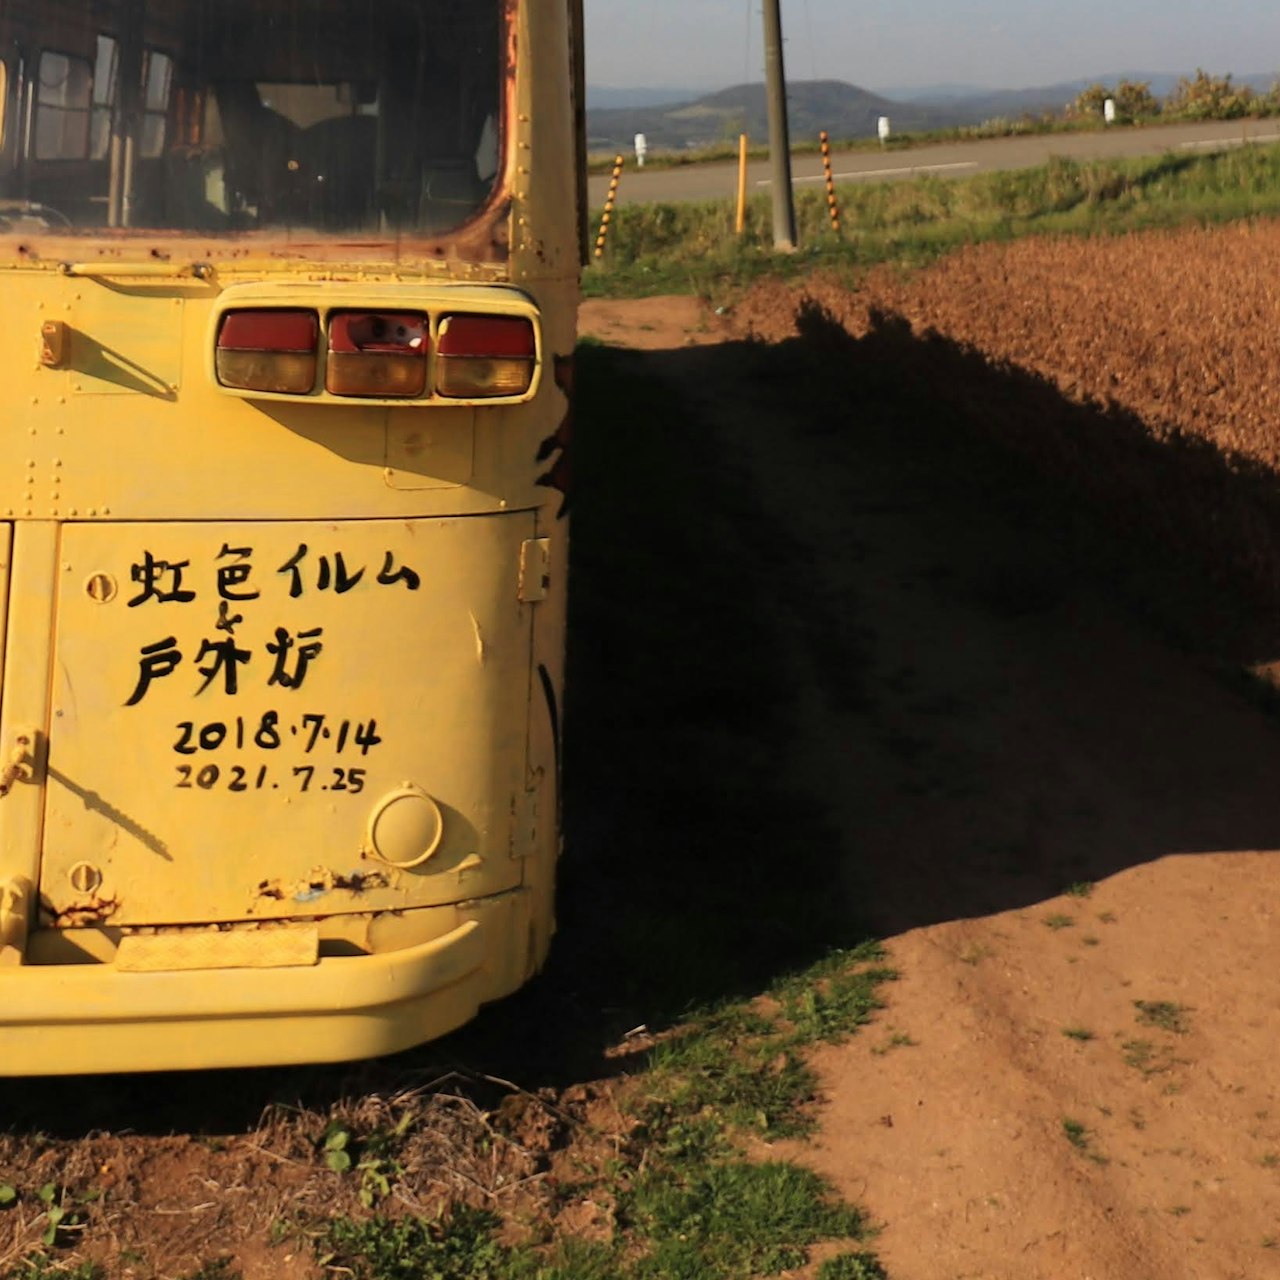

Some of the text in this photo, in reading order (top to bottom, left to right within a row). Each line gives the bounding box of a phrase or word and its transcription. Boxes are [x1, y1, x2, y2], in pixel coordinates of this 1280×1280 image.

[126, 543, 421, 608] 虹色イルム
